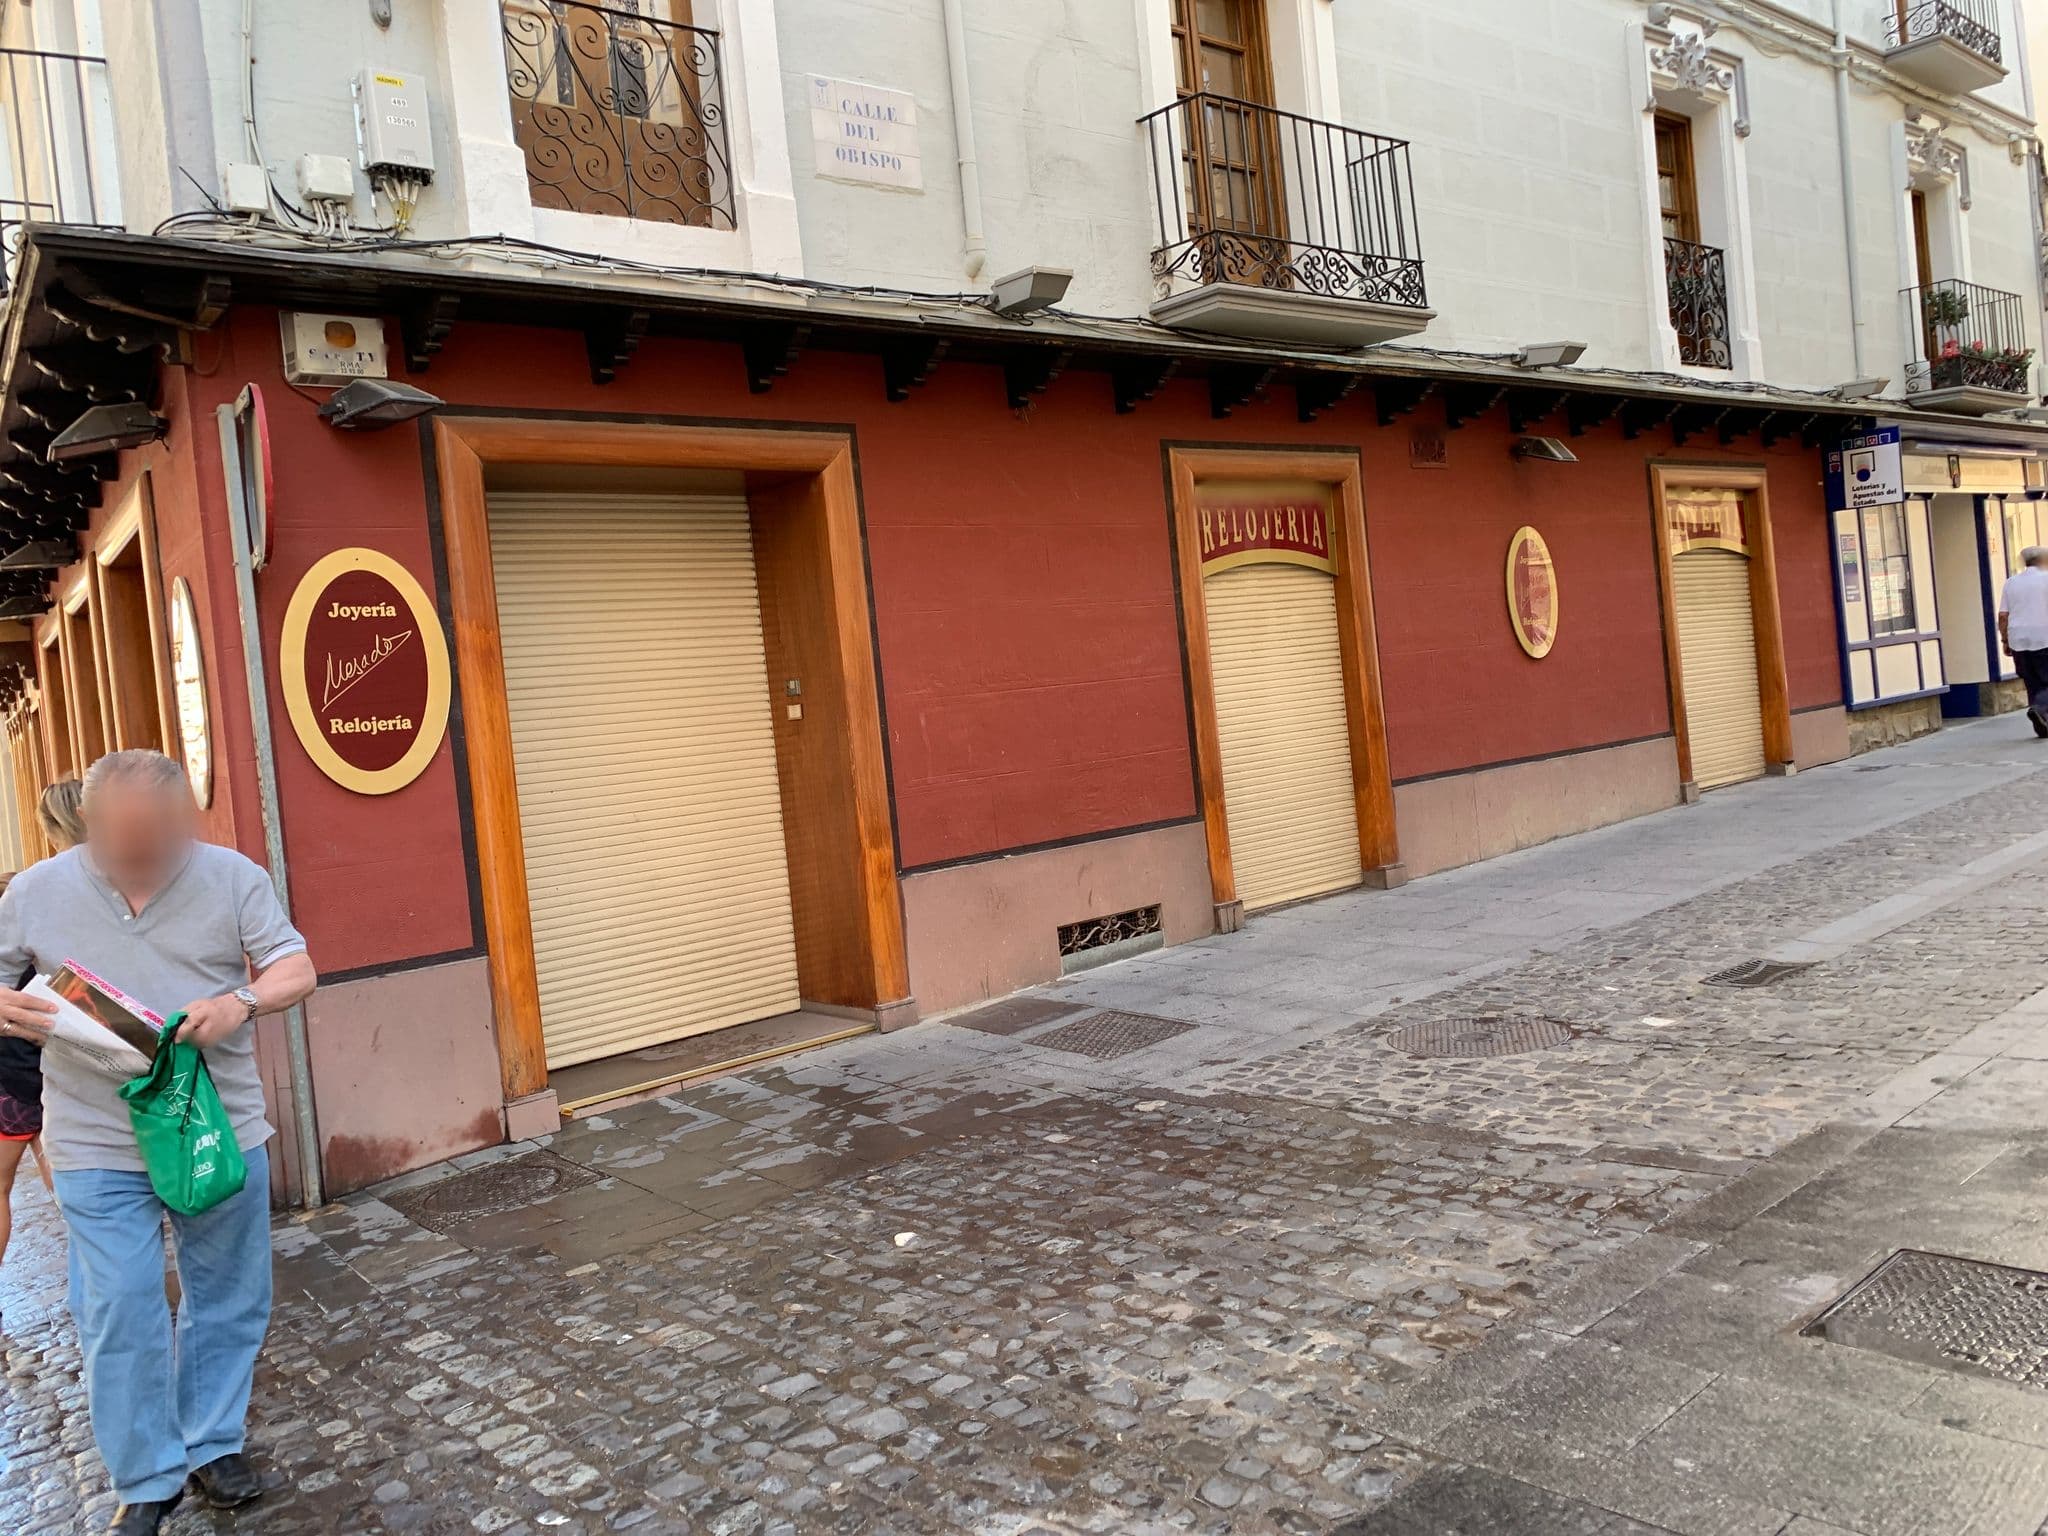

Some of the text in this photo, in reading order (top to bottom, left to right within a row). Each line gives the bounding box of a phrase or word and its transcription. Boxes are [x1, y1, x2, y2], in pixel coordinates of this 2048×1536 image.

[842, 99, 898, 121] CALLE
[845, 122, 880, 141] DEL
[836, 147, 902, 171] OBISPO
[1853, 491, 1885, 499] Apuestas
[1201, 506, 1324, 554] RELOJERIA
[328, 602, 397, 621] Joyería
[329, 715, 412, 736] Relojería
